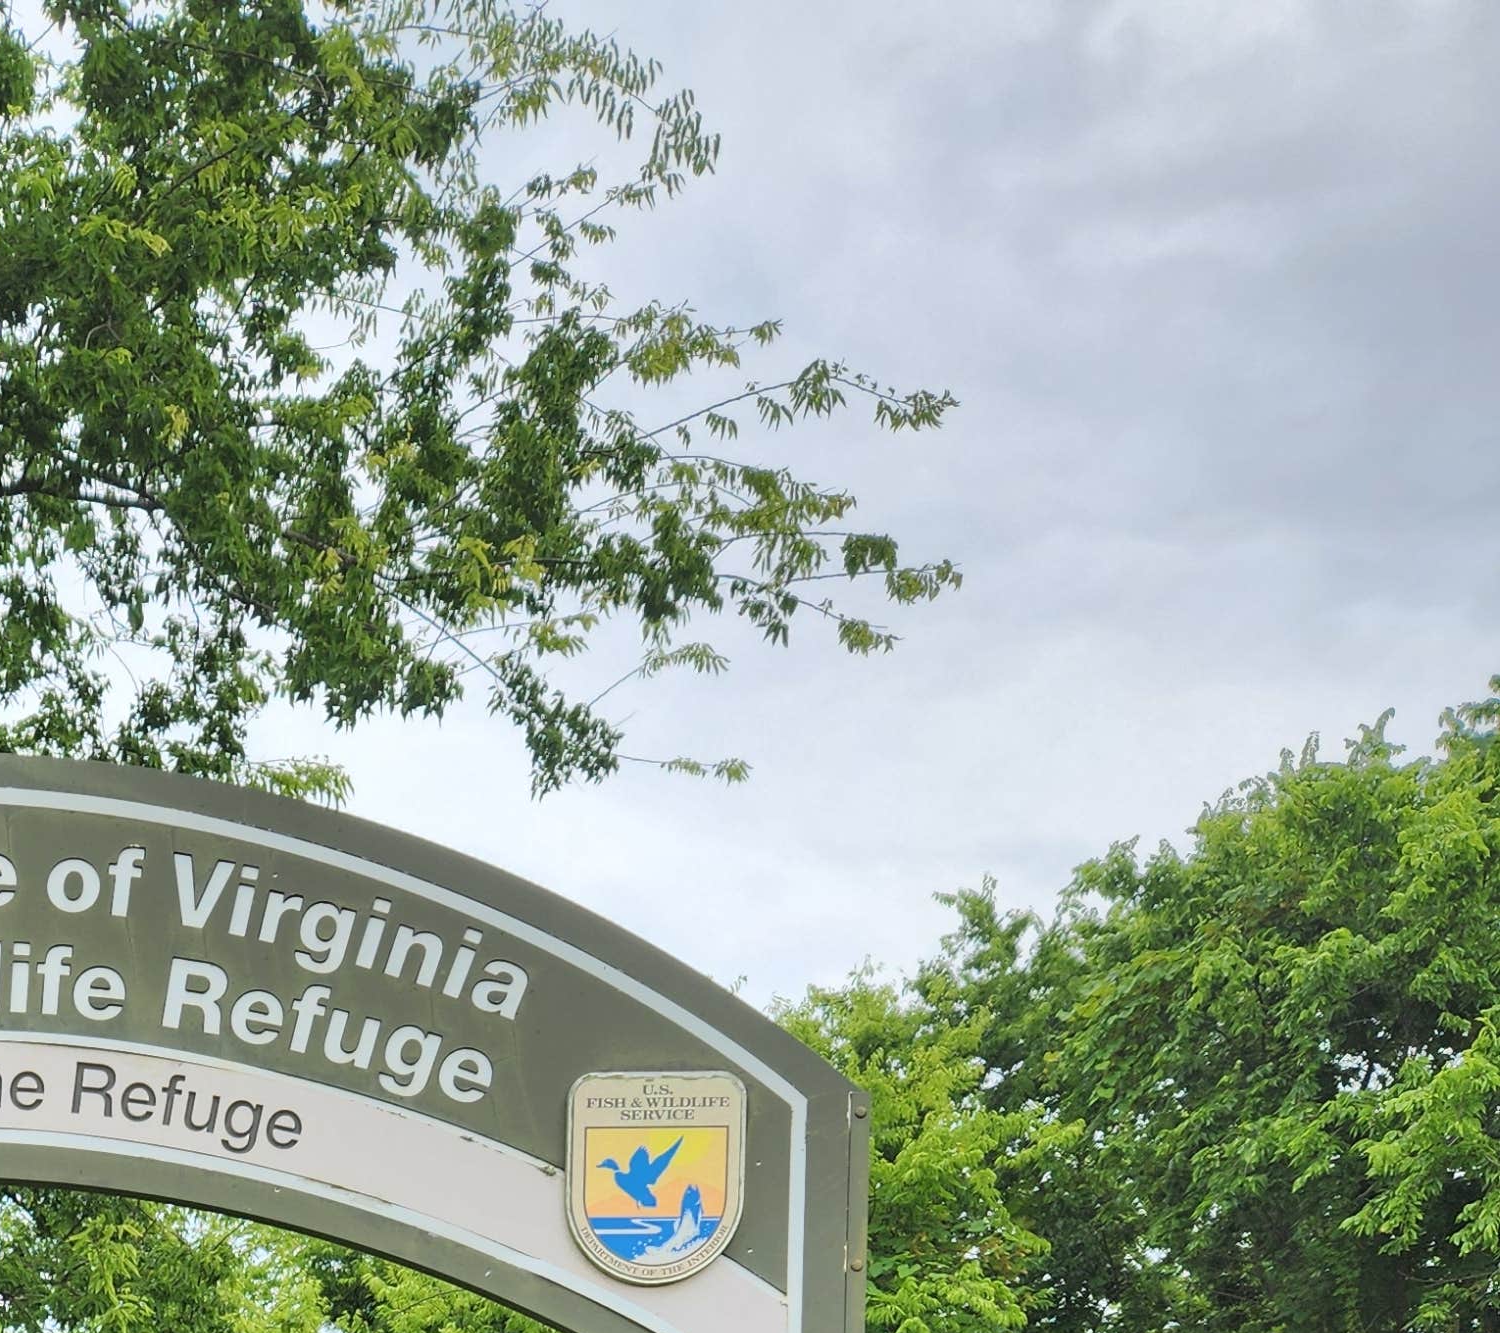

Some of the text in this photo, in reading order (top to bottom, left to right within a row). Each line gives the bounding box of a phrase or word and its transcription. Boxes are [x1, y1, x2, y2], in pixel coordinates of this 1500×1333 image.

[46, 845, 146, 918] of
[173, 851, 529, 1020] Virginia
[162, 956, 493, 1104] Refuge
[70, 1060, 303, 1154] Refuge
[586, 1096, 731, 1109] FISH & WILDLIFE
[620, 1109, 696, 1121] SERVICE
[642, 1084, 674, 1096] U.S.
[580, 1225, 730, 1277] DEPARTMENT OF THE INTERIOR
